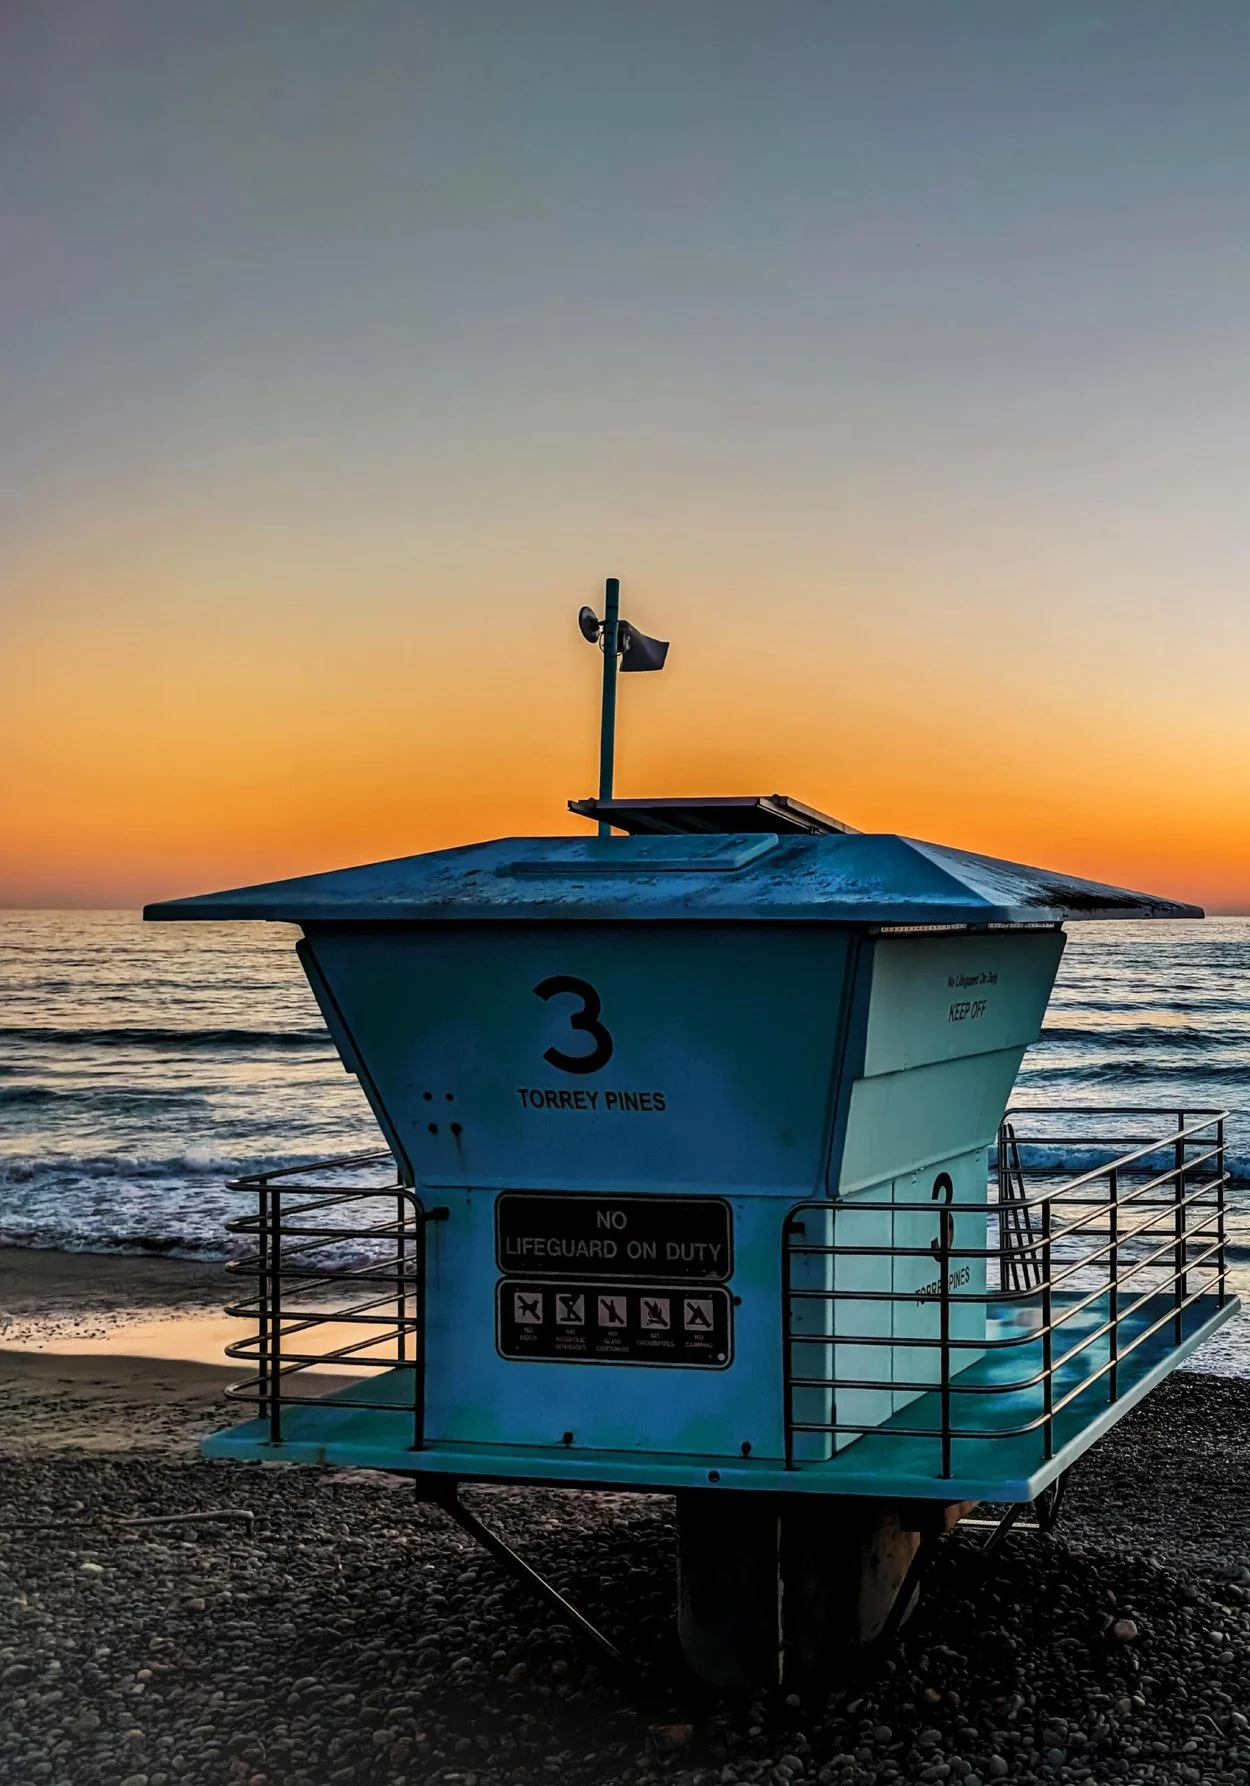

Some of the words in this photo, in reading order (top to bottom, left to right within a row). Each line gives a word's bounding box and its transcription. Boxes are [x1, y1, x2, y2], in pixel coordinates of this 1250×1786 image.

[949, 1002, 970, 1022] KEEP
[971, 1000, 987, 1019] OFF
[532, 975, 613, 1074] 3
[516, 1088, 598, 1110] TORREY
[604, 1091, 666, 1112] PINES
[596, 1210, 628, 1230] NO
[505, 1236, 618, 1259] LIFEGUARD
[626, 1240, 657, 1260] ON
[666, 1242, 722, 1262] DUTY
[948, 1266, 970, 1291] PINES
